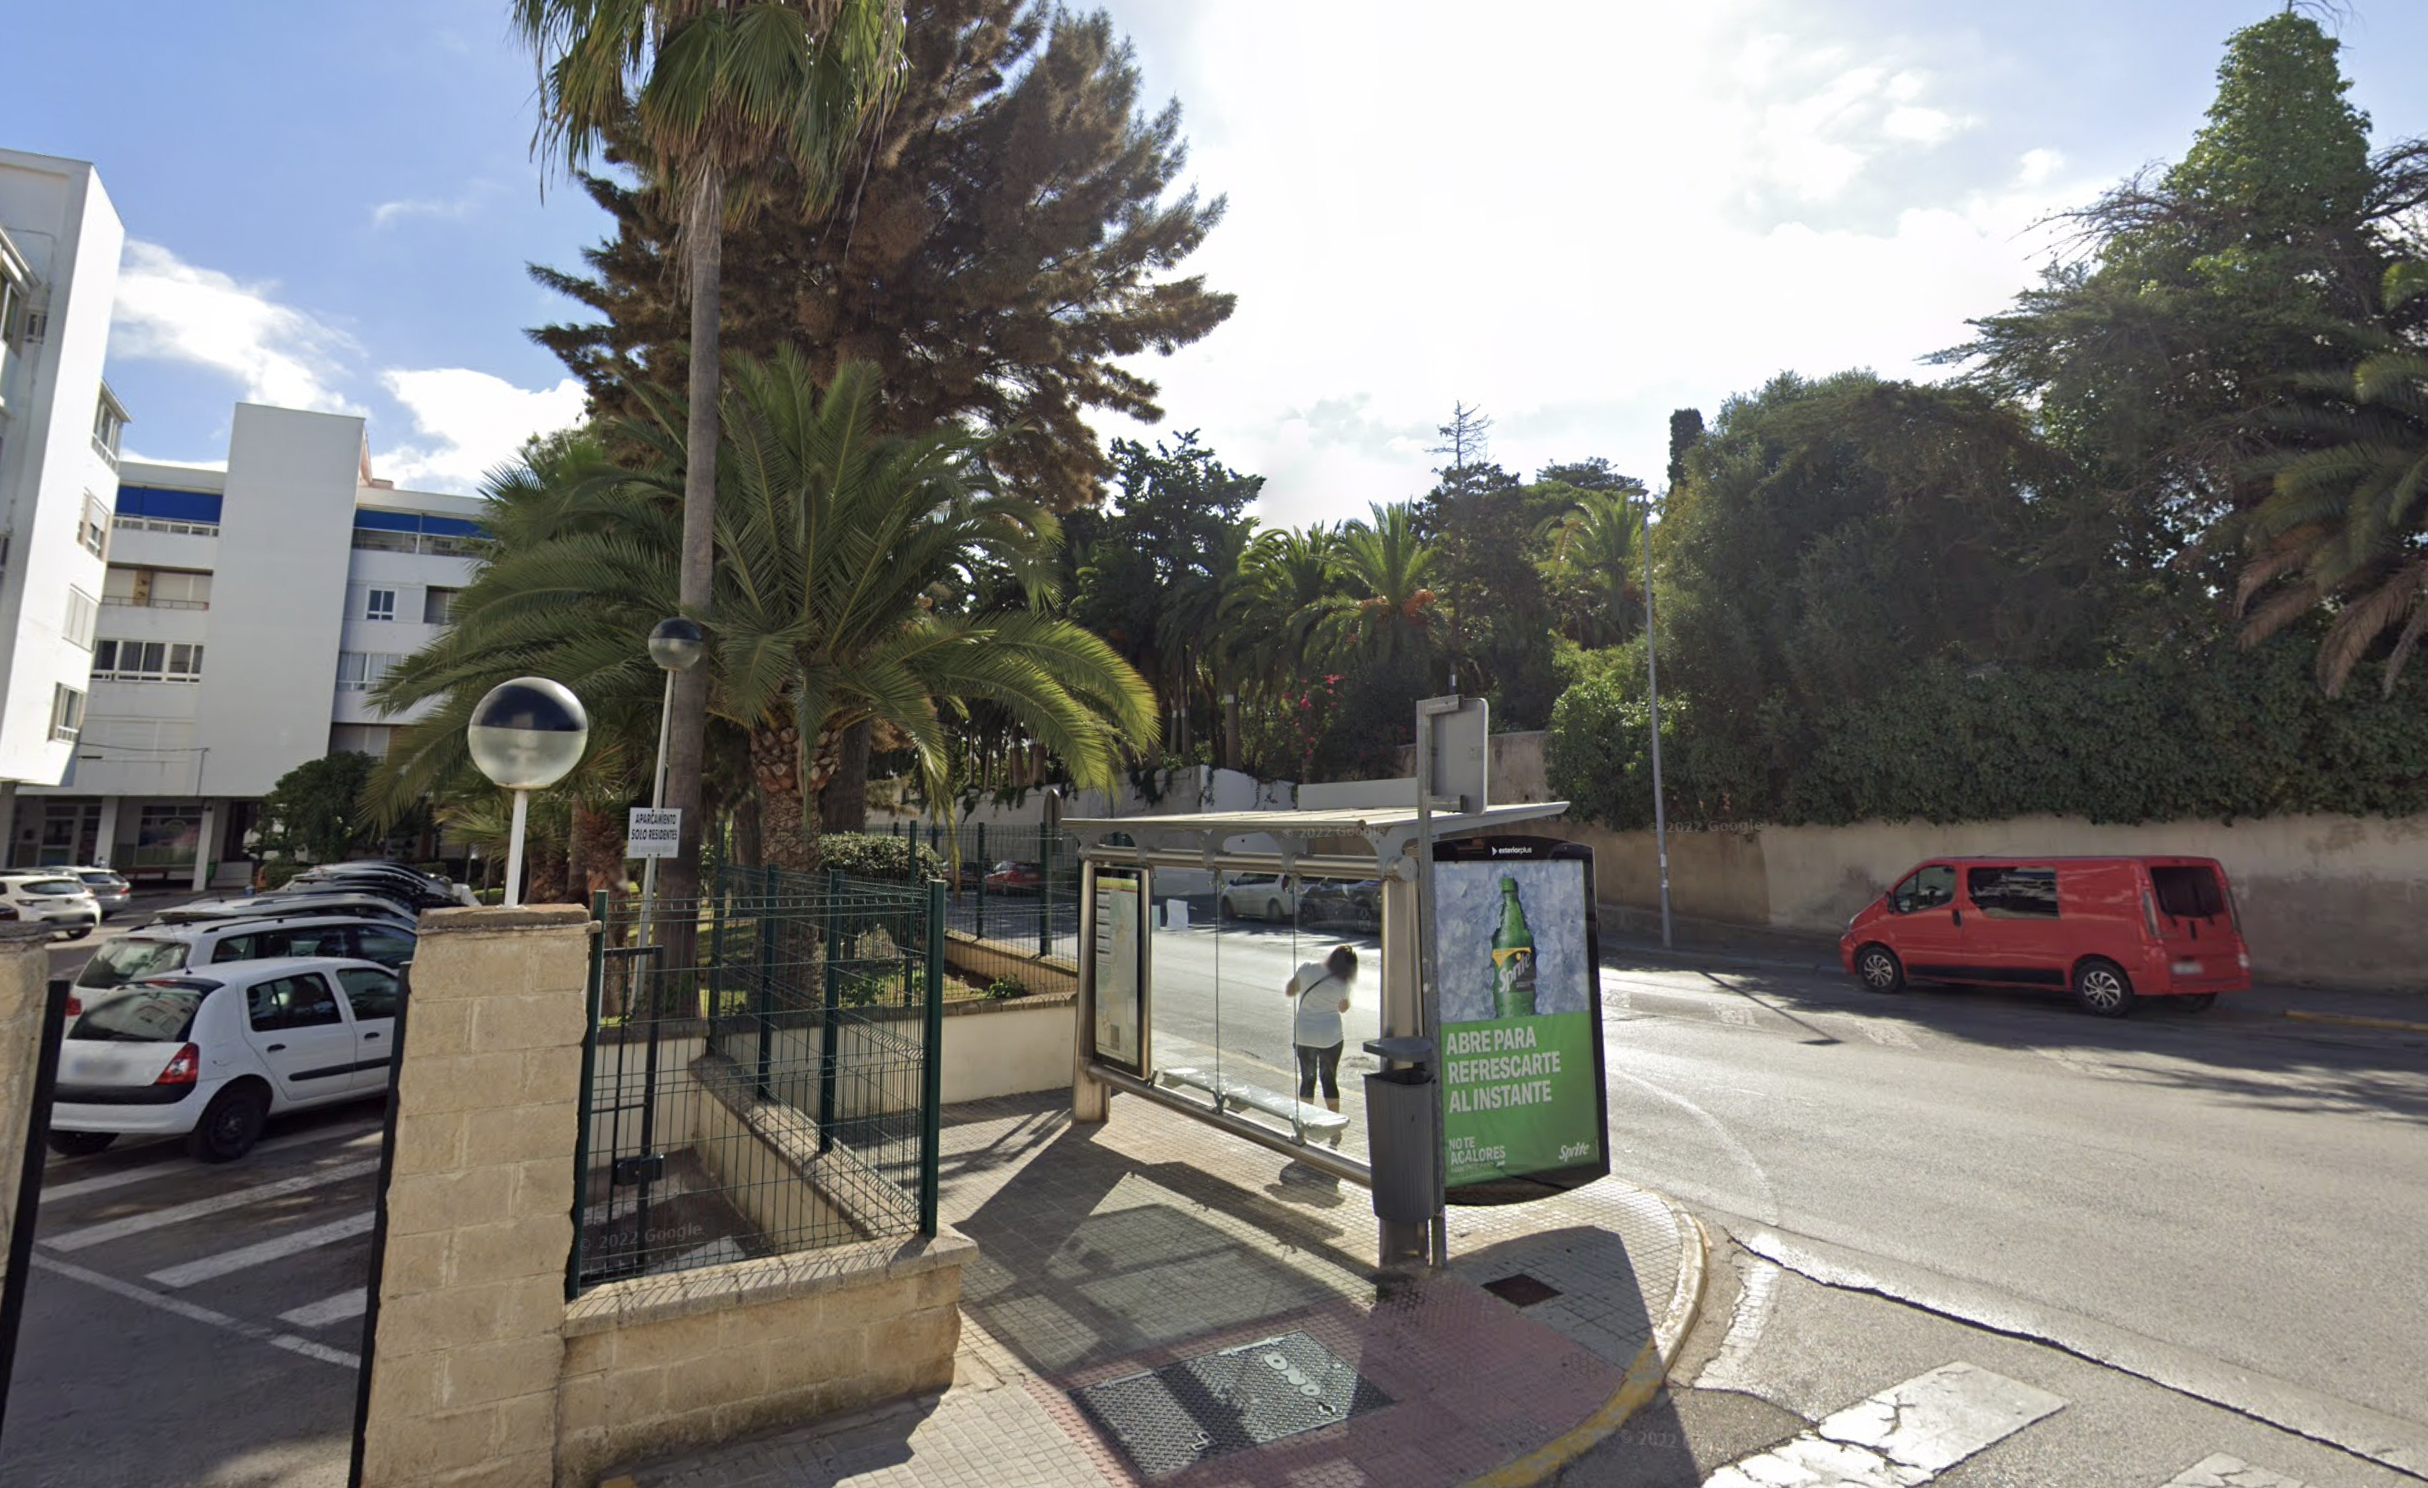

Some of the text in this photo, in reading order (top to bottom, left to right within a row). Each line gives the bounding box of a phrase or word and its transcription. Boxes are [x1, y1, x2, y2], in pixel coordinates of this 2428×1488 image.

[635, 813, 677, 825] APARCAMIENTO
[631, 828, 678, 840] SOLO RESIDENTES
[1498, 846, 1533, 855] exteriorplus
[1498, 952, 1531, 993] Sprite
[1446, 1026, 1537, 1055] ABRE PARA
[1448, 1051, 1562, 1085] REFRESCARTE
[1449, 1080, 1552, 1113] AL INSTANTE
[1449, 1136, 1476, 1151] NO TE
[1558, 1142, 1591, 1162] Sprite
[1451, 1145, 1506, 1165] ACALORES
